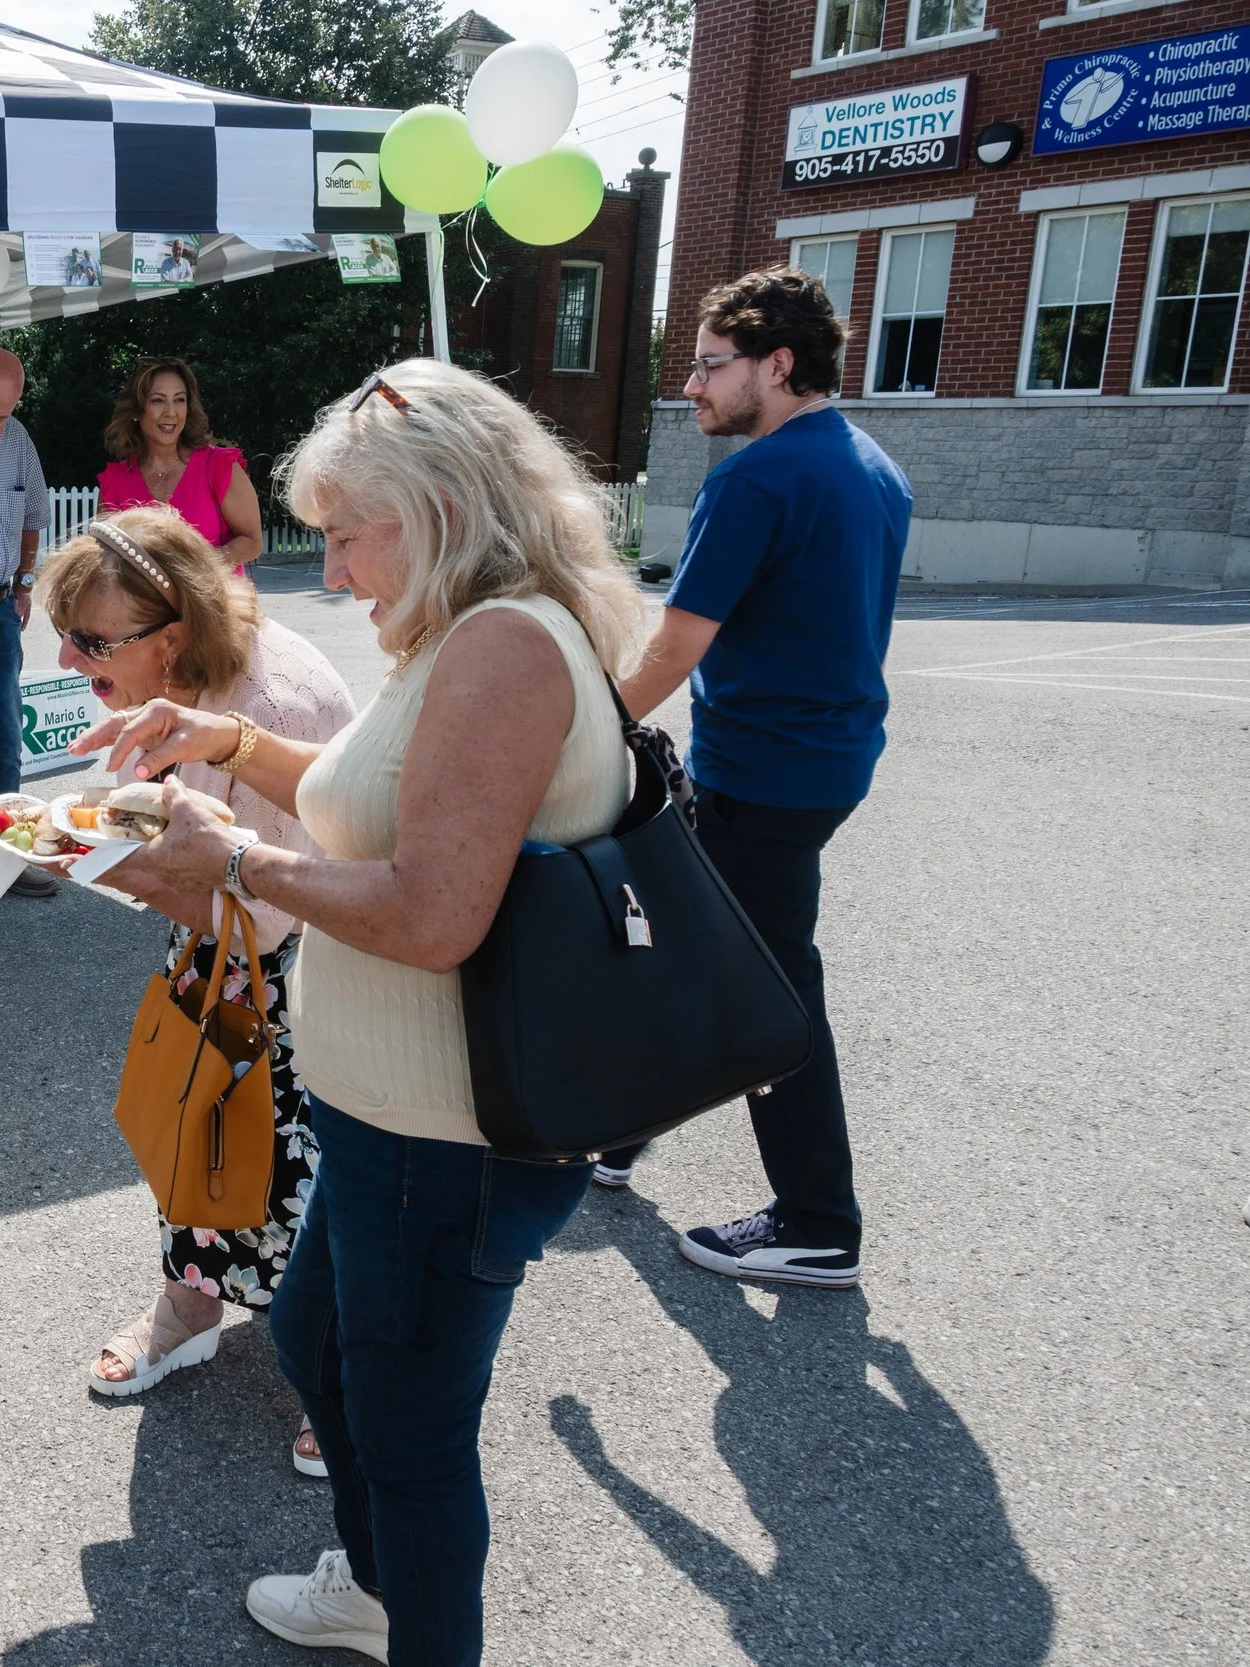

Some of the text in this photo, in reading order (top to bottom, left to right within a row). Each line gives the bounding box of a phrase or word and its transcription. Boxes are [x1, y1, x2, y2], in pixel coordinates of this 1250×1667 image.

[1158, 32, 1240, 62] Chiropractic
[1043, 54, 1141, 109] Primo Chiropractic
[1154, 57, 1250, 85] Physiotherapy
[825, 86, 957, 123] Vellore Woods
[1150, 82, 1236, 108] Acupuncture
[820, 109, 955, 150] DENTISTRY
[1041, 88, 1139, 143] & Wellness Centre
[1147, 110, 1204, 132] Massage
[794, 140, 945, 182] 905-417-5550
[325, 176, 372, 191] ShelterLogic
[44, 706, 85, 726] Mario G
